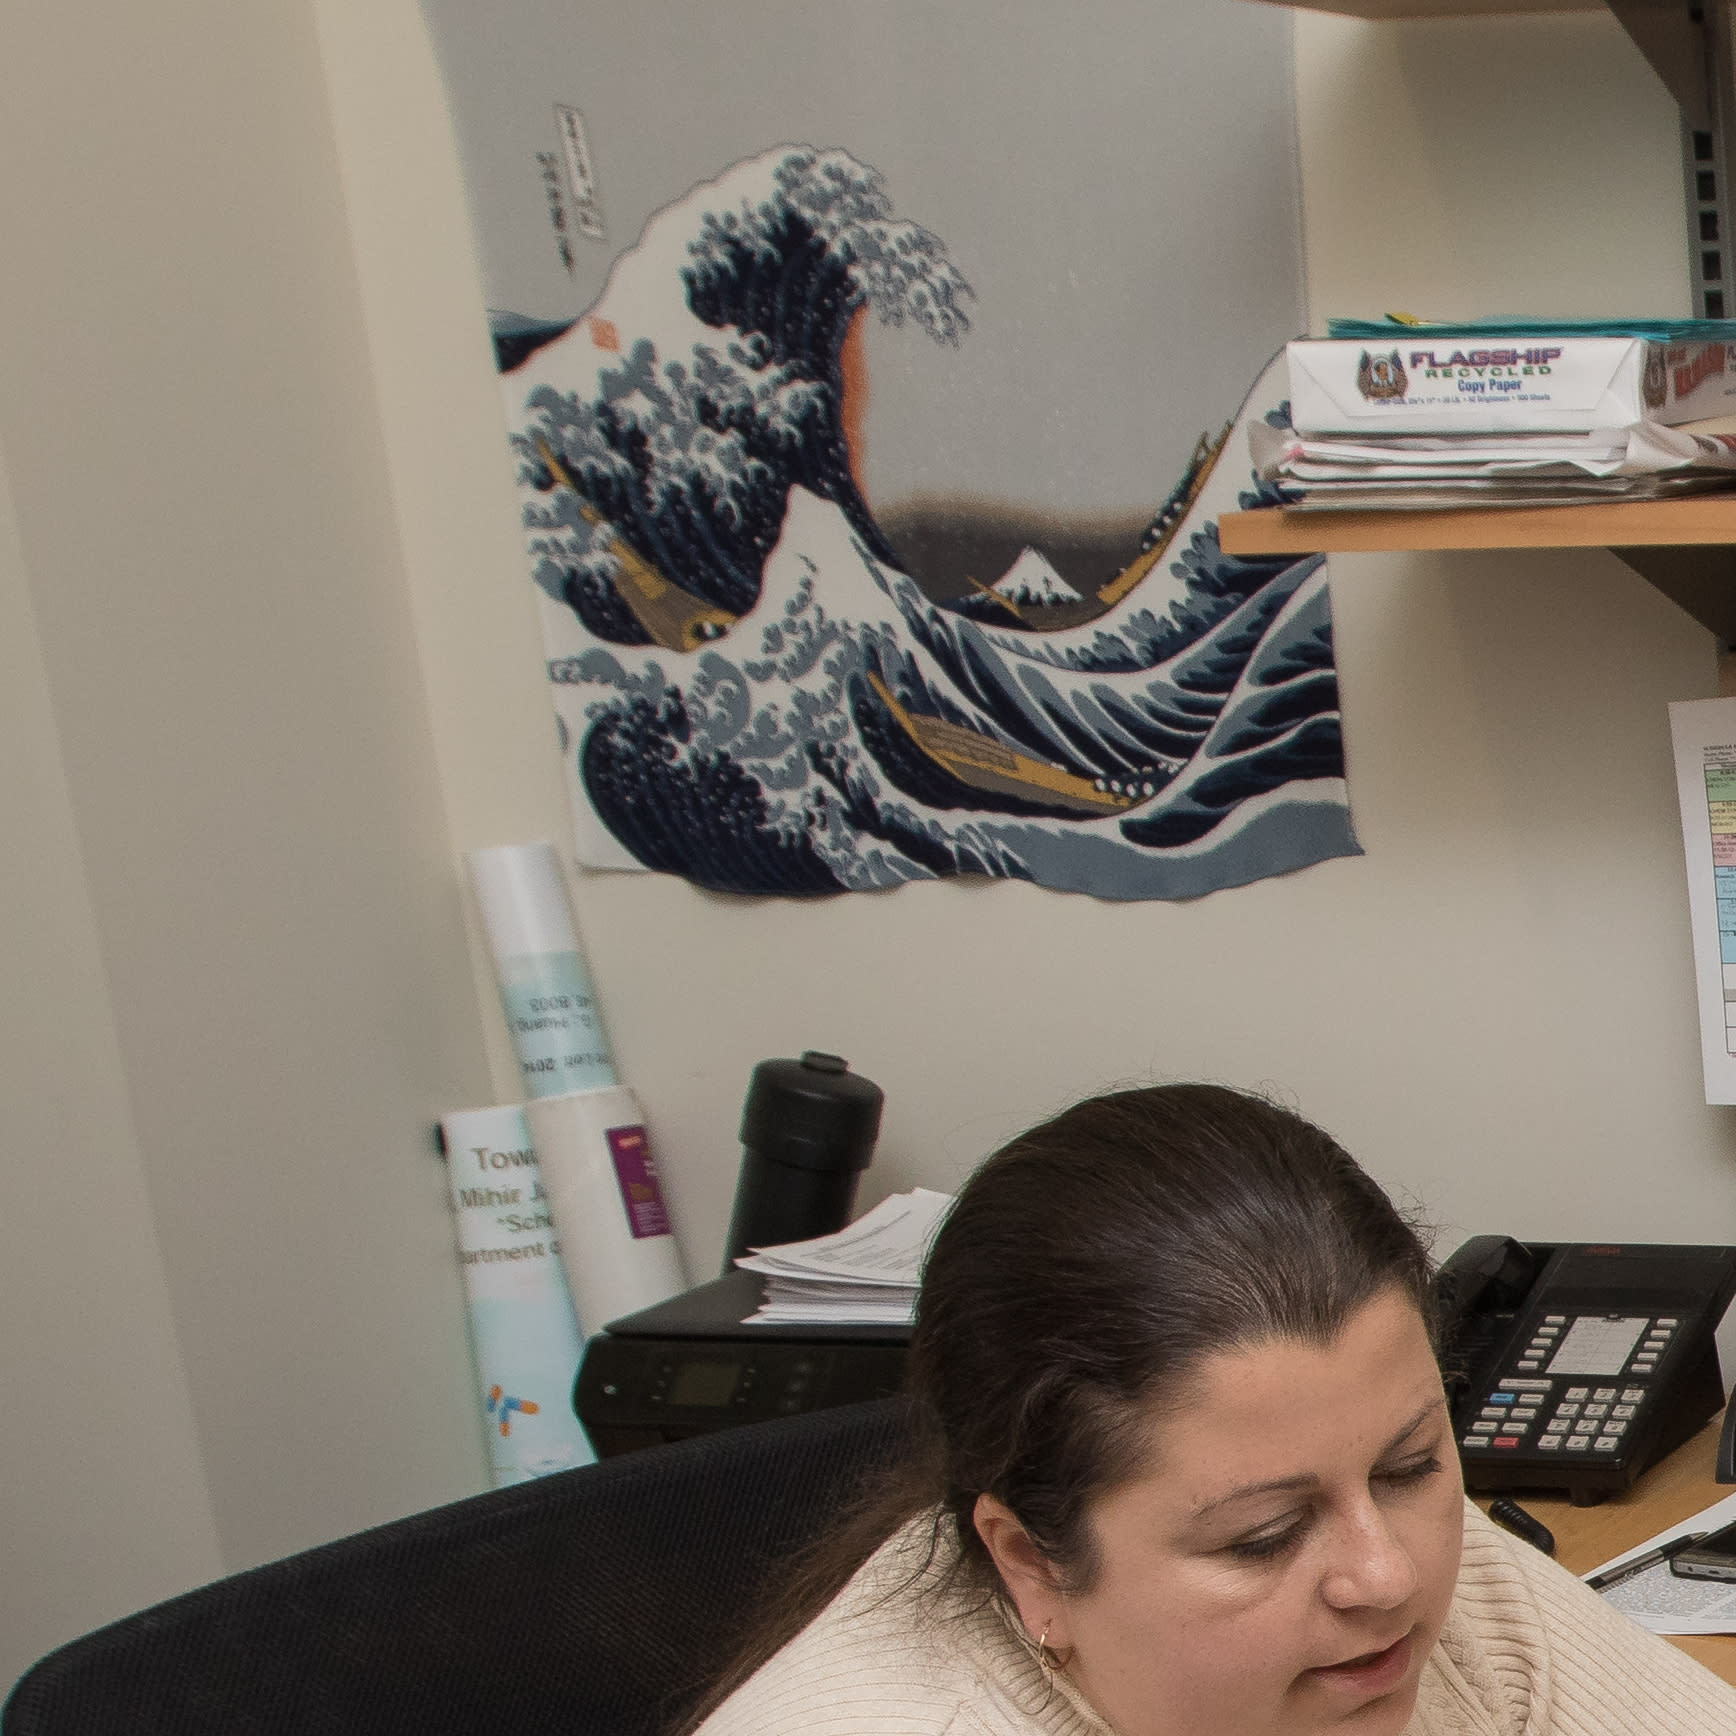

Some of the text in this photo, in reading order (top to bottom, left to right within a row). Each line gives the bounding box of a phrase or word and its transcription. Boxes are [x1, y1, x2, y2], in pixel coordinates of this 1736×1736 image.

[1410, 347, 1564, 368] FLAGSHIP
[1425, 366, 1551, 378] RECYCLED
[1458, 379, 1522, 393] Copy Paper
